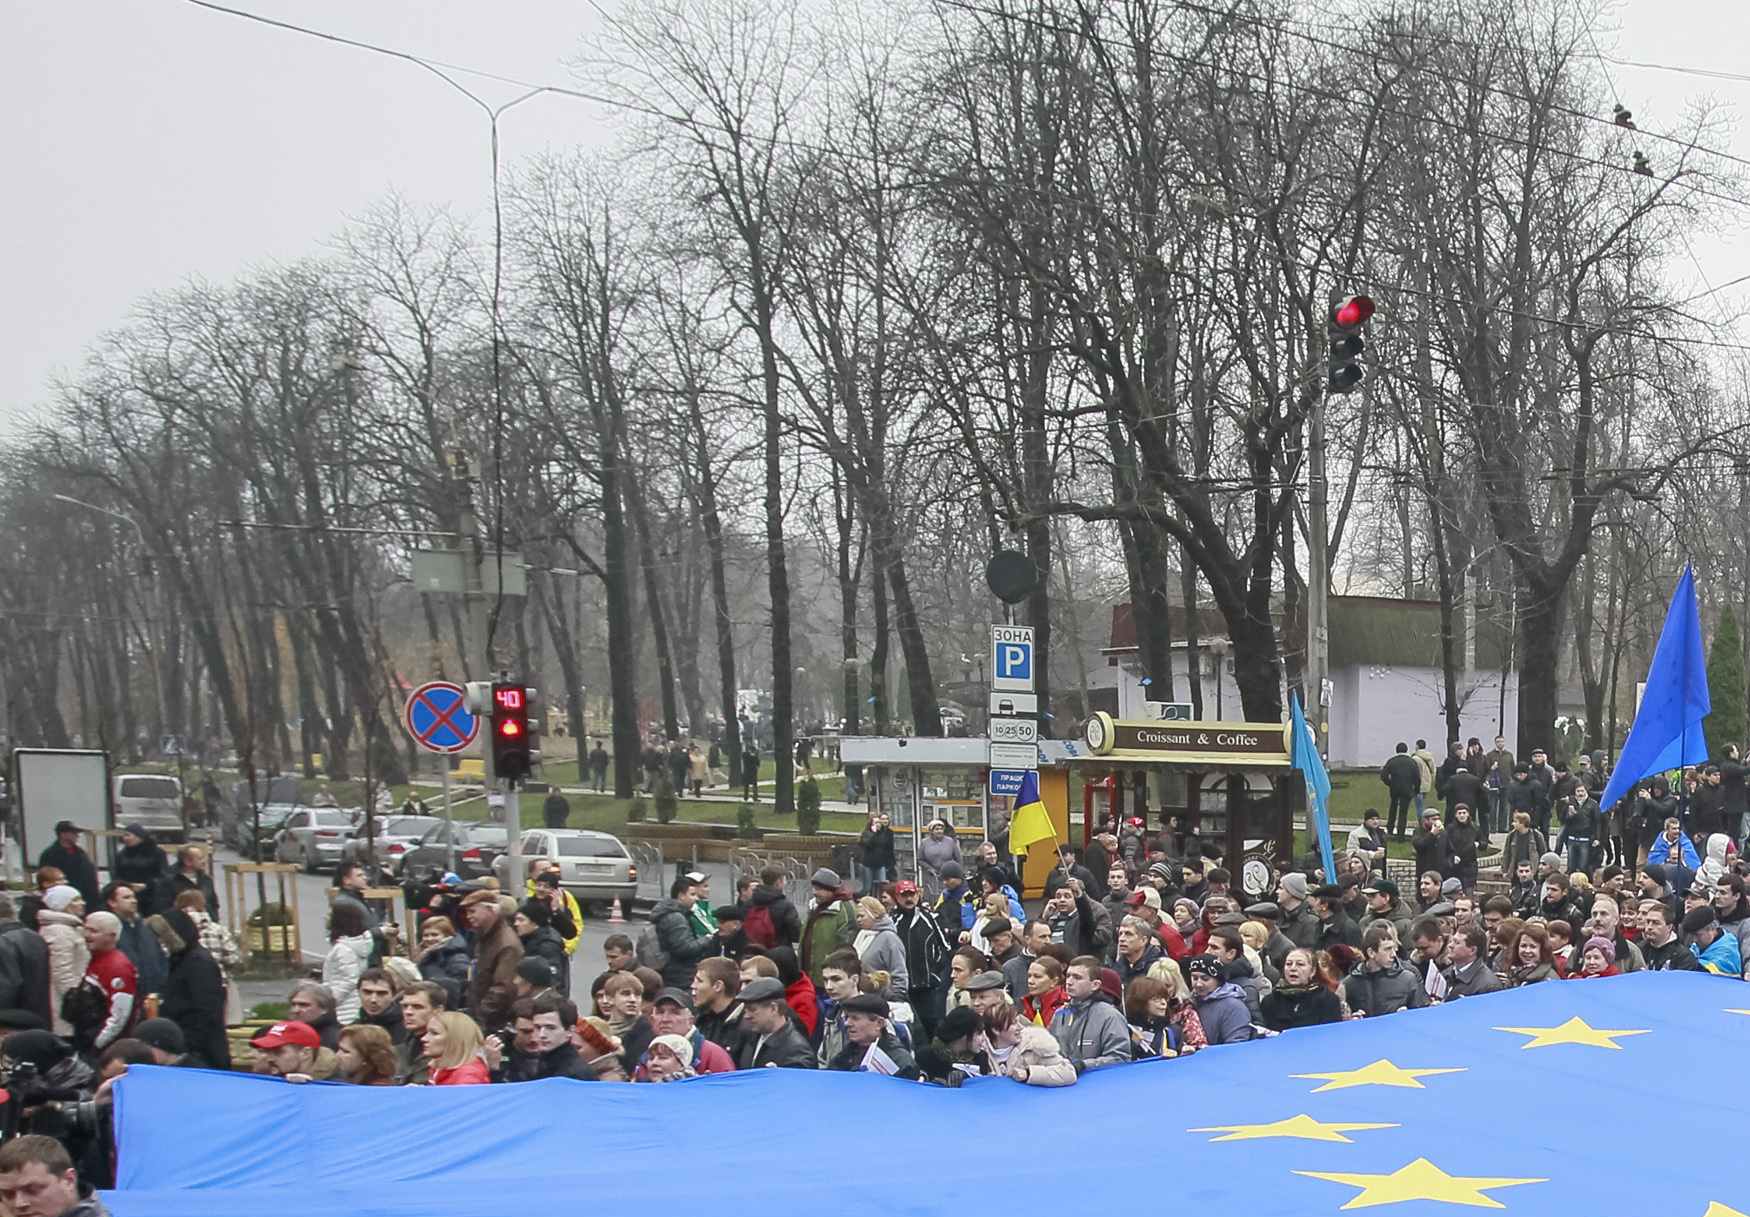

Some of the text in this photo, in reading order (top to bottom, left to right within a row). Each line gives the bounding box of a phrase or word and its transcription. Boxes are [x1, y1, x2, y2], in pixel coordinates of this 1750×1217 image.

[994, 629, 1032, 642] ЗОНА
[496, 690, 521, 708] 40
[1005, 726, 1017, 735] 25
[1018, 726, 1032, 736] 50
[1136, 730, 1259, 747] Croissant & Coffee
